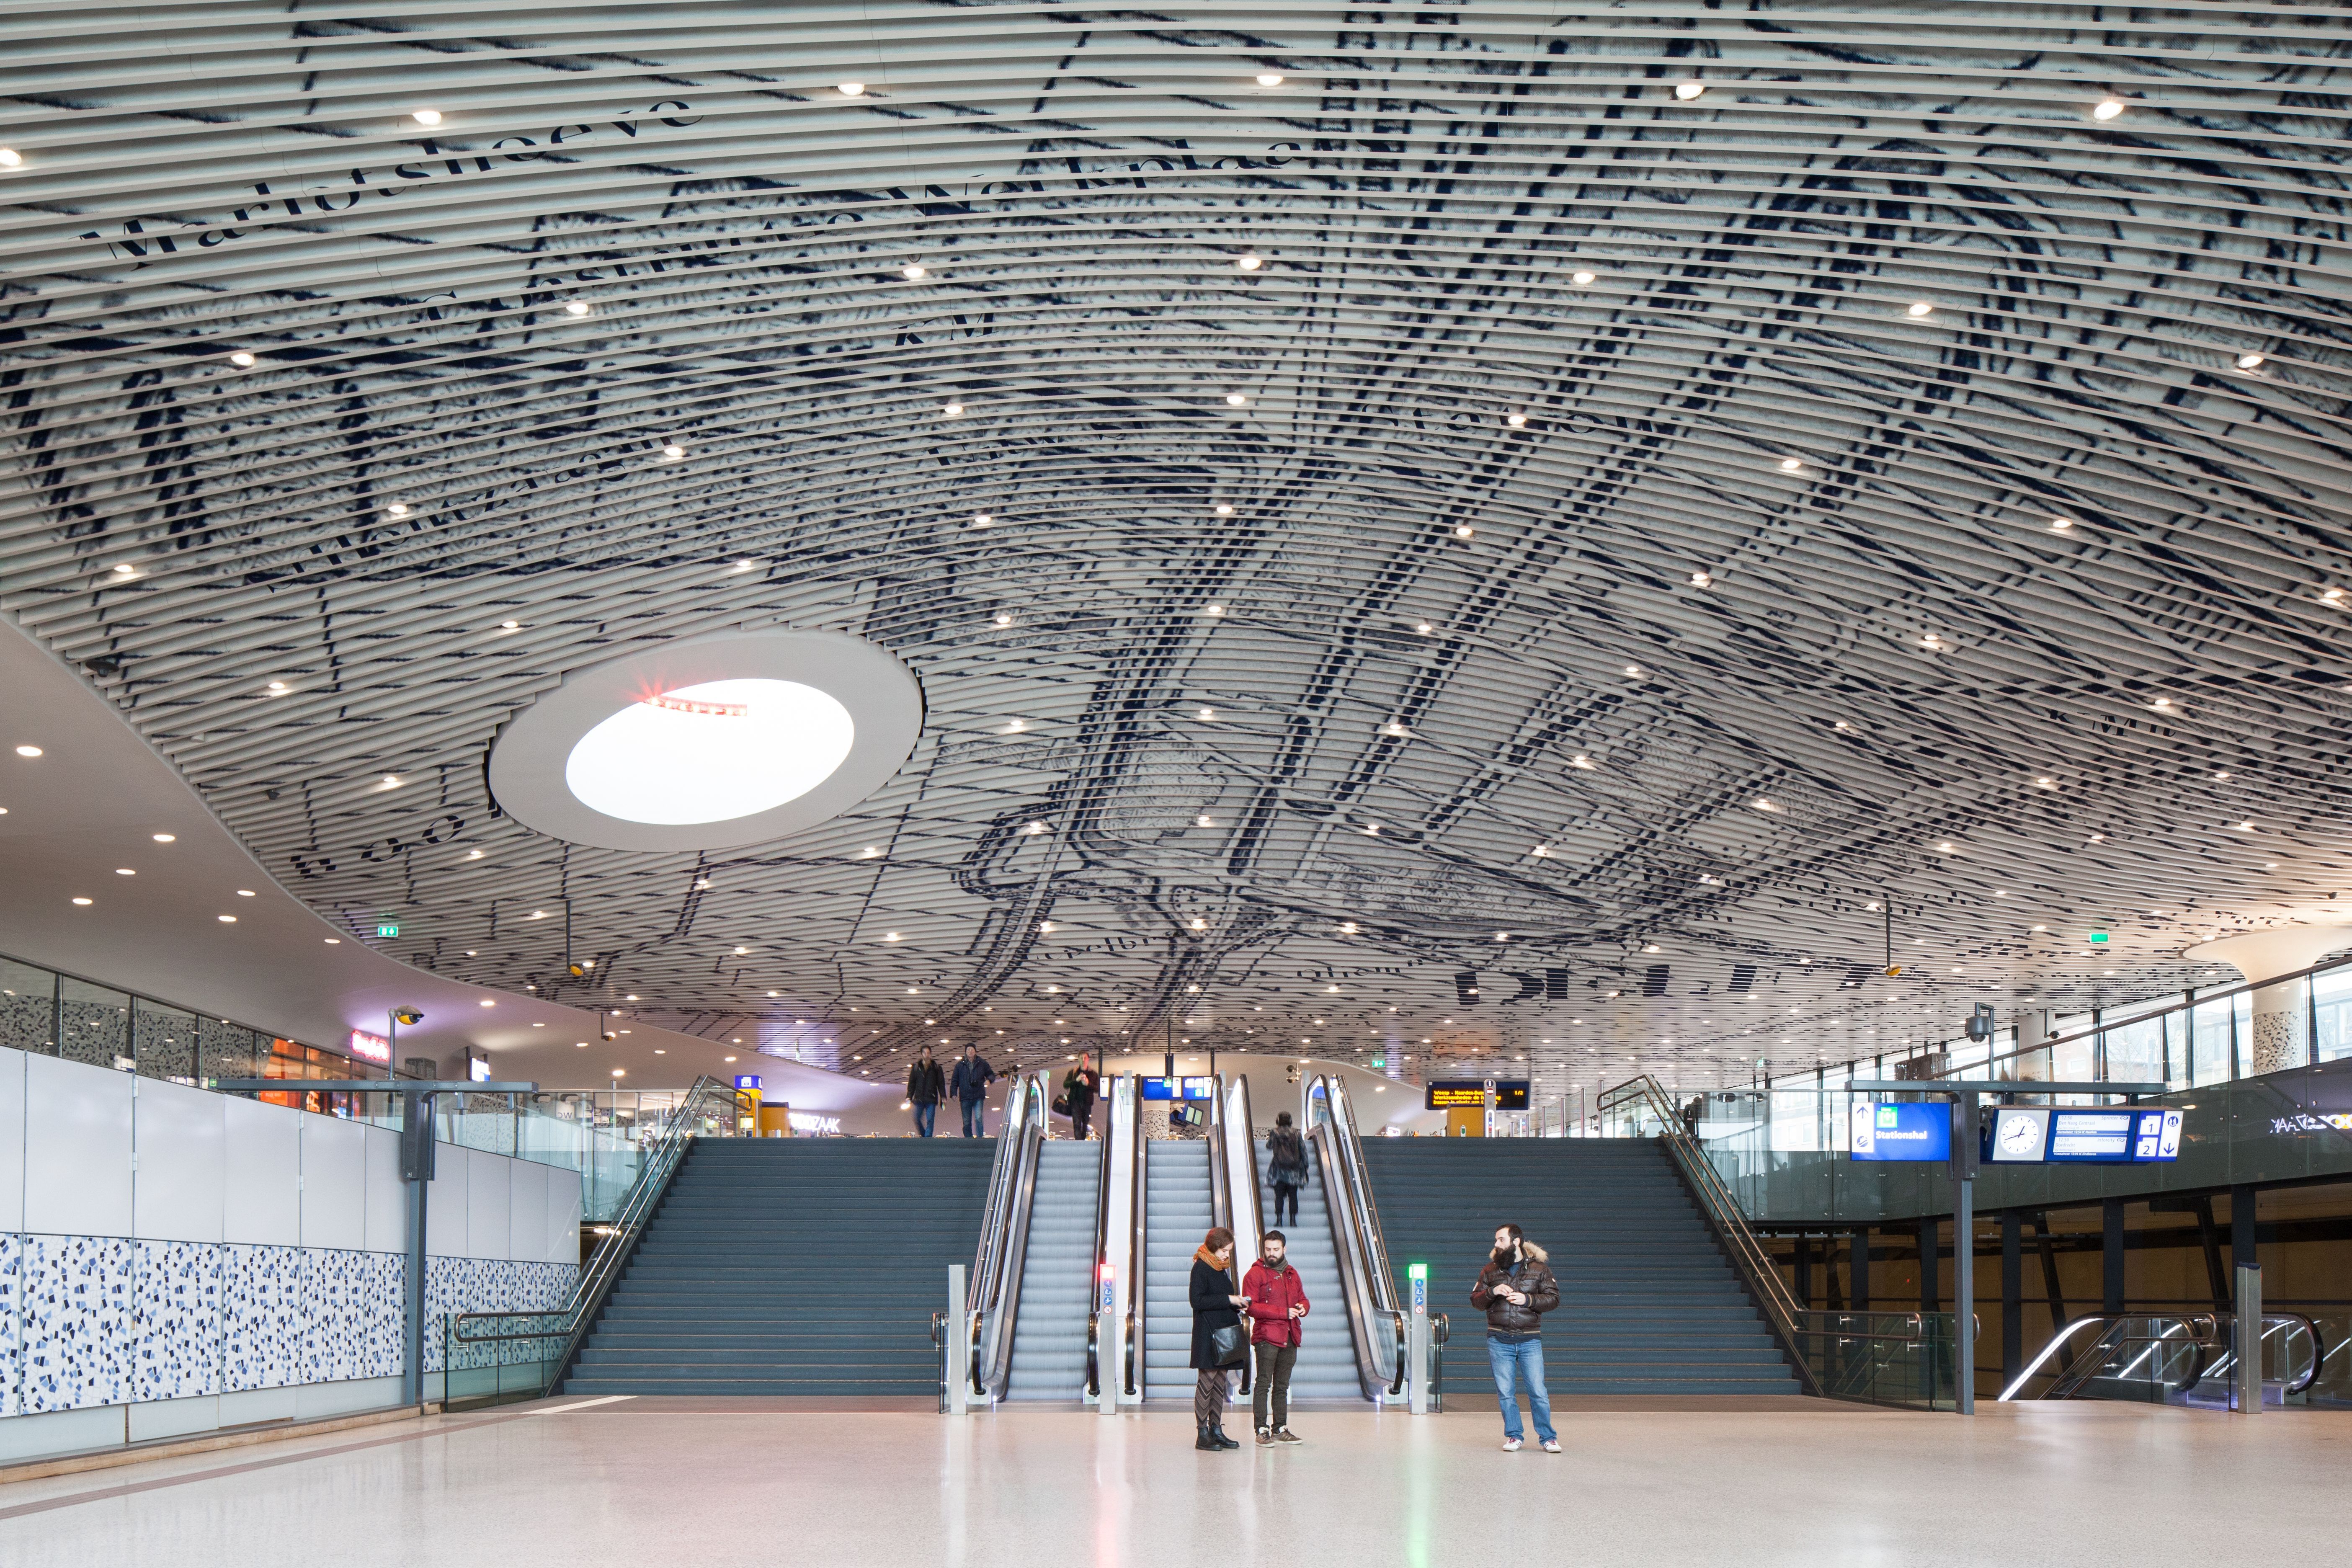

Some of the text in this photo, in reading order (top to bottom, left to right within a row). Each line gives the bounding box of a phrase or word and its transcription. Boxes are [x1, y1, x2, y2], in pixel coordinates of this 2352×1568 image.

[2148, 1124, 2153, 1133] 1
[1876, 1131, 1927, 1139] Stationshal
[2143, 1145, 2150, 1155] 2
